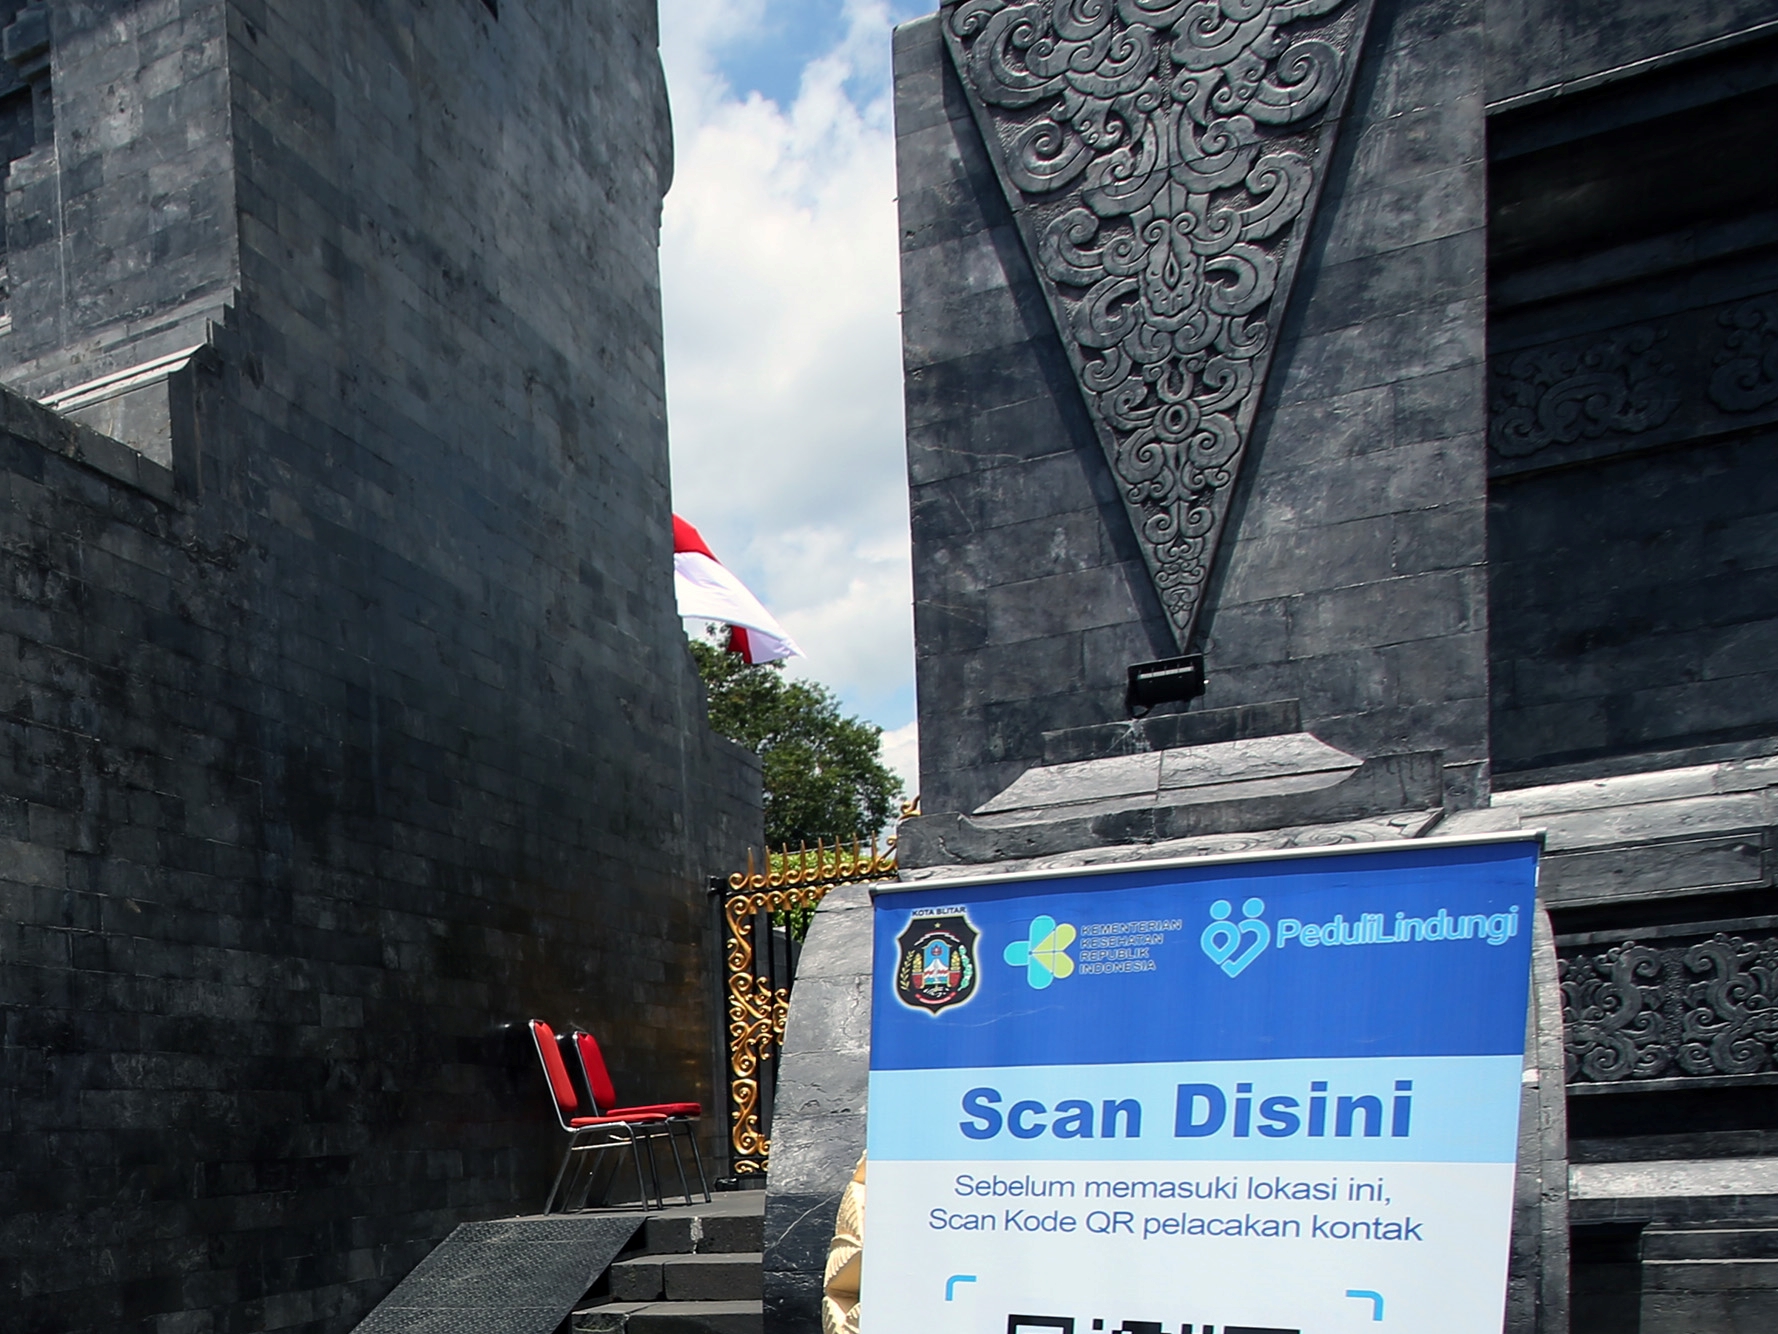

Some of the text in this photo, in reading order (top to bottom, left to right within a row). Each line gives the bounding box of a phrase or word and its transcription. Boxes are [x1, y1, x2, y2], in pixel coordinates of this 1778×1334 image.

[912, 906, 967, 917] KOTA BLITAR
[1081, 919, 1183, 936] KEMENTERIAN
[1275, 905, 1520, 949] PeduliLindungi
[1080, 933, 1164, 949] KESEHATAN
[1079, 947, 1150, 962] REPUBLIK
[1079, 960, 1157, 975] INDONESIA
[959, 1079, 1414, 1140] Scan Disini
[954, 1174, 1391, 1206] Sebelum memasuki lokasi ini,
[929, 1208, 1424, 1242] Scan Kode QR pelacakan kontak
